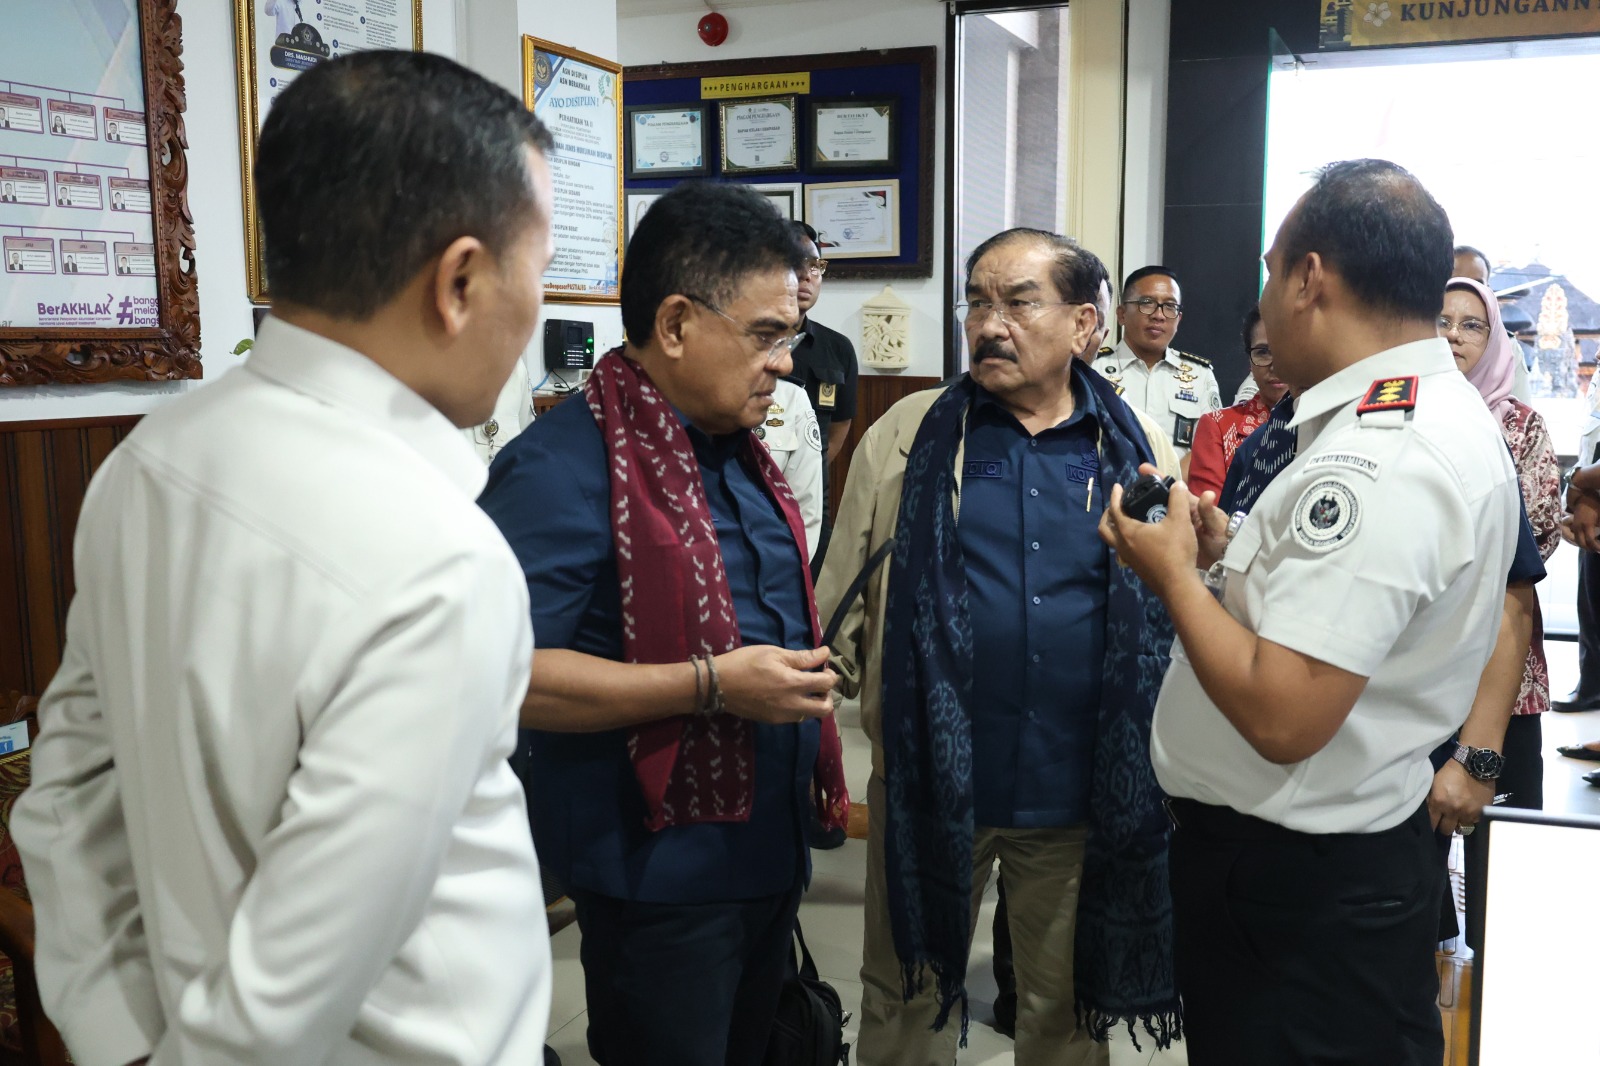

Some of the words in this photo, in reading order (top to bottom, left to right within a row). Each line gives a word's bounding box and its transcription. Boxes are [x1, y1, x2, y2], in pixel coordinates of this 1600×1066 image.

[1401, 0, 1600, 21] KUNJUNGANN
[720, 80, 788, 92] PENGHARGAAN
[549, 97, 564, 108] AYO
[566, 96, 596, 108] DISIPLIN
[38, 302, 112, 315] BerAKHLAK
